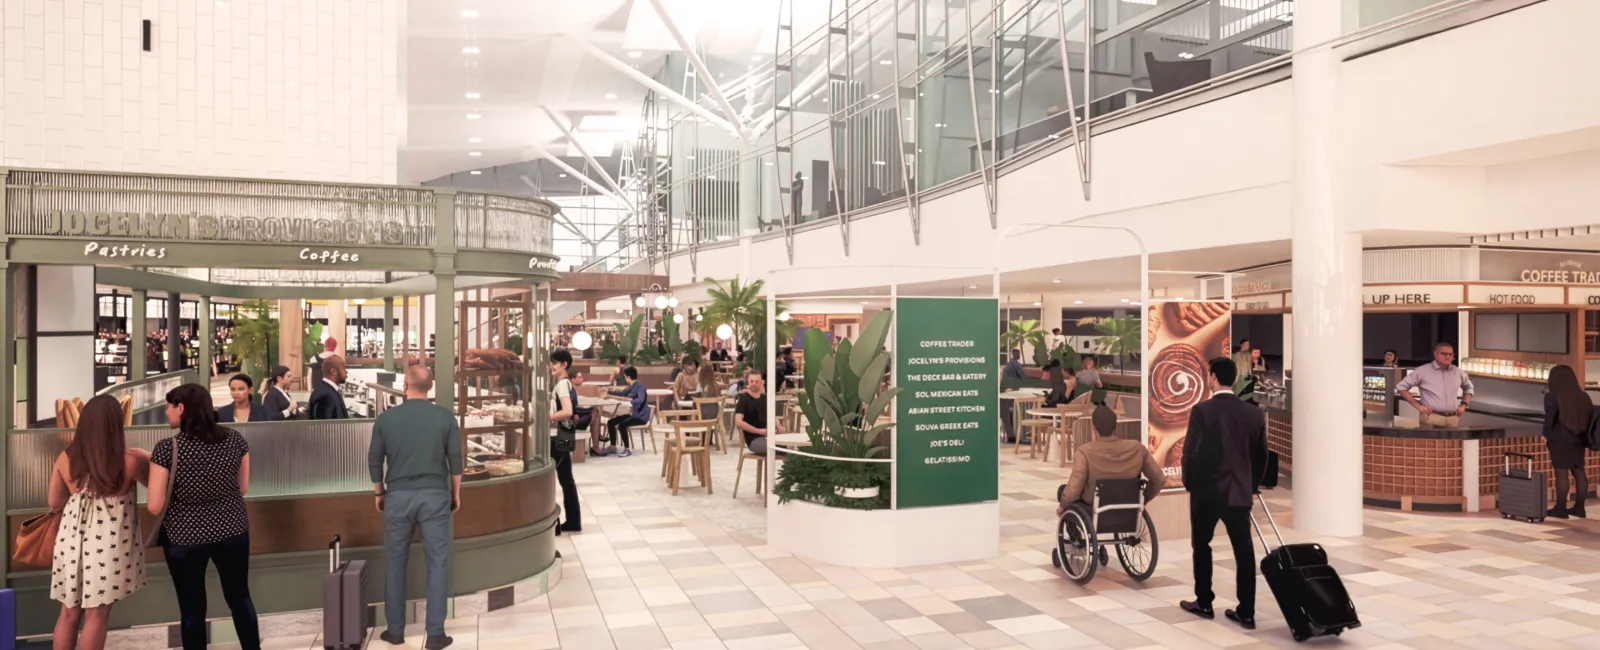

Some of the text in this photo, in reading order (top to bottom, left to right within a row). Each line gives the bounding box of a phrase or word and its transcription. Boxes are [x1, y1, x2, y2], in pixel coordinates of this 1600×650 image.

[45, 209, 404, 245] JOCELYN'S PROVISIONS
[83, 241, 167, 259] Pastries
[299, 247, 360, 264] Coffee
[1521, 269, 1569, 283] COFFEE
[1372, 294, 1390, 305] UP
[1395, 293, 1431, 305] HERE
[1489, 294, 1536, 305] HOT FOOD
[920, 340, 975, 348] COFFEE TRADER
[908, 356, 986, 365] JOCELYN'S PROVISIONS
[907, 374, 921, 382] THE
[942, 373, 956, 381] BAR
[956, 373, 962, 381] &
[962, 373, 987, 381] EATERY
[930, 390, 962, 398] MEXICAN
[963, 389, 979, 397] EATS
[908, 405, 985, 415] ASIAN STREET KITCHEN
[939, 422, 962, 430] GREEK
[963, 421, 979, 429] EATS
[930, 440, 948, 448] JOE'S
[924, 455, 970, 464] GELATISSIMO
